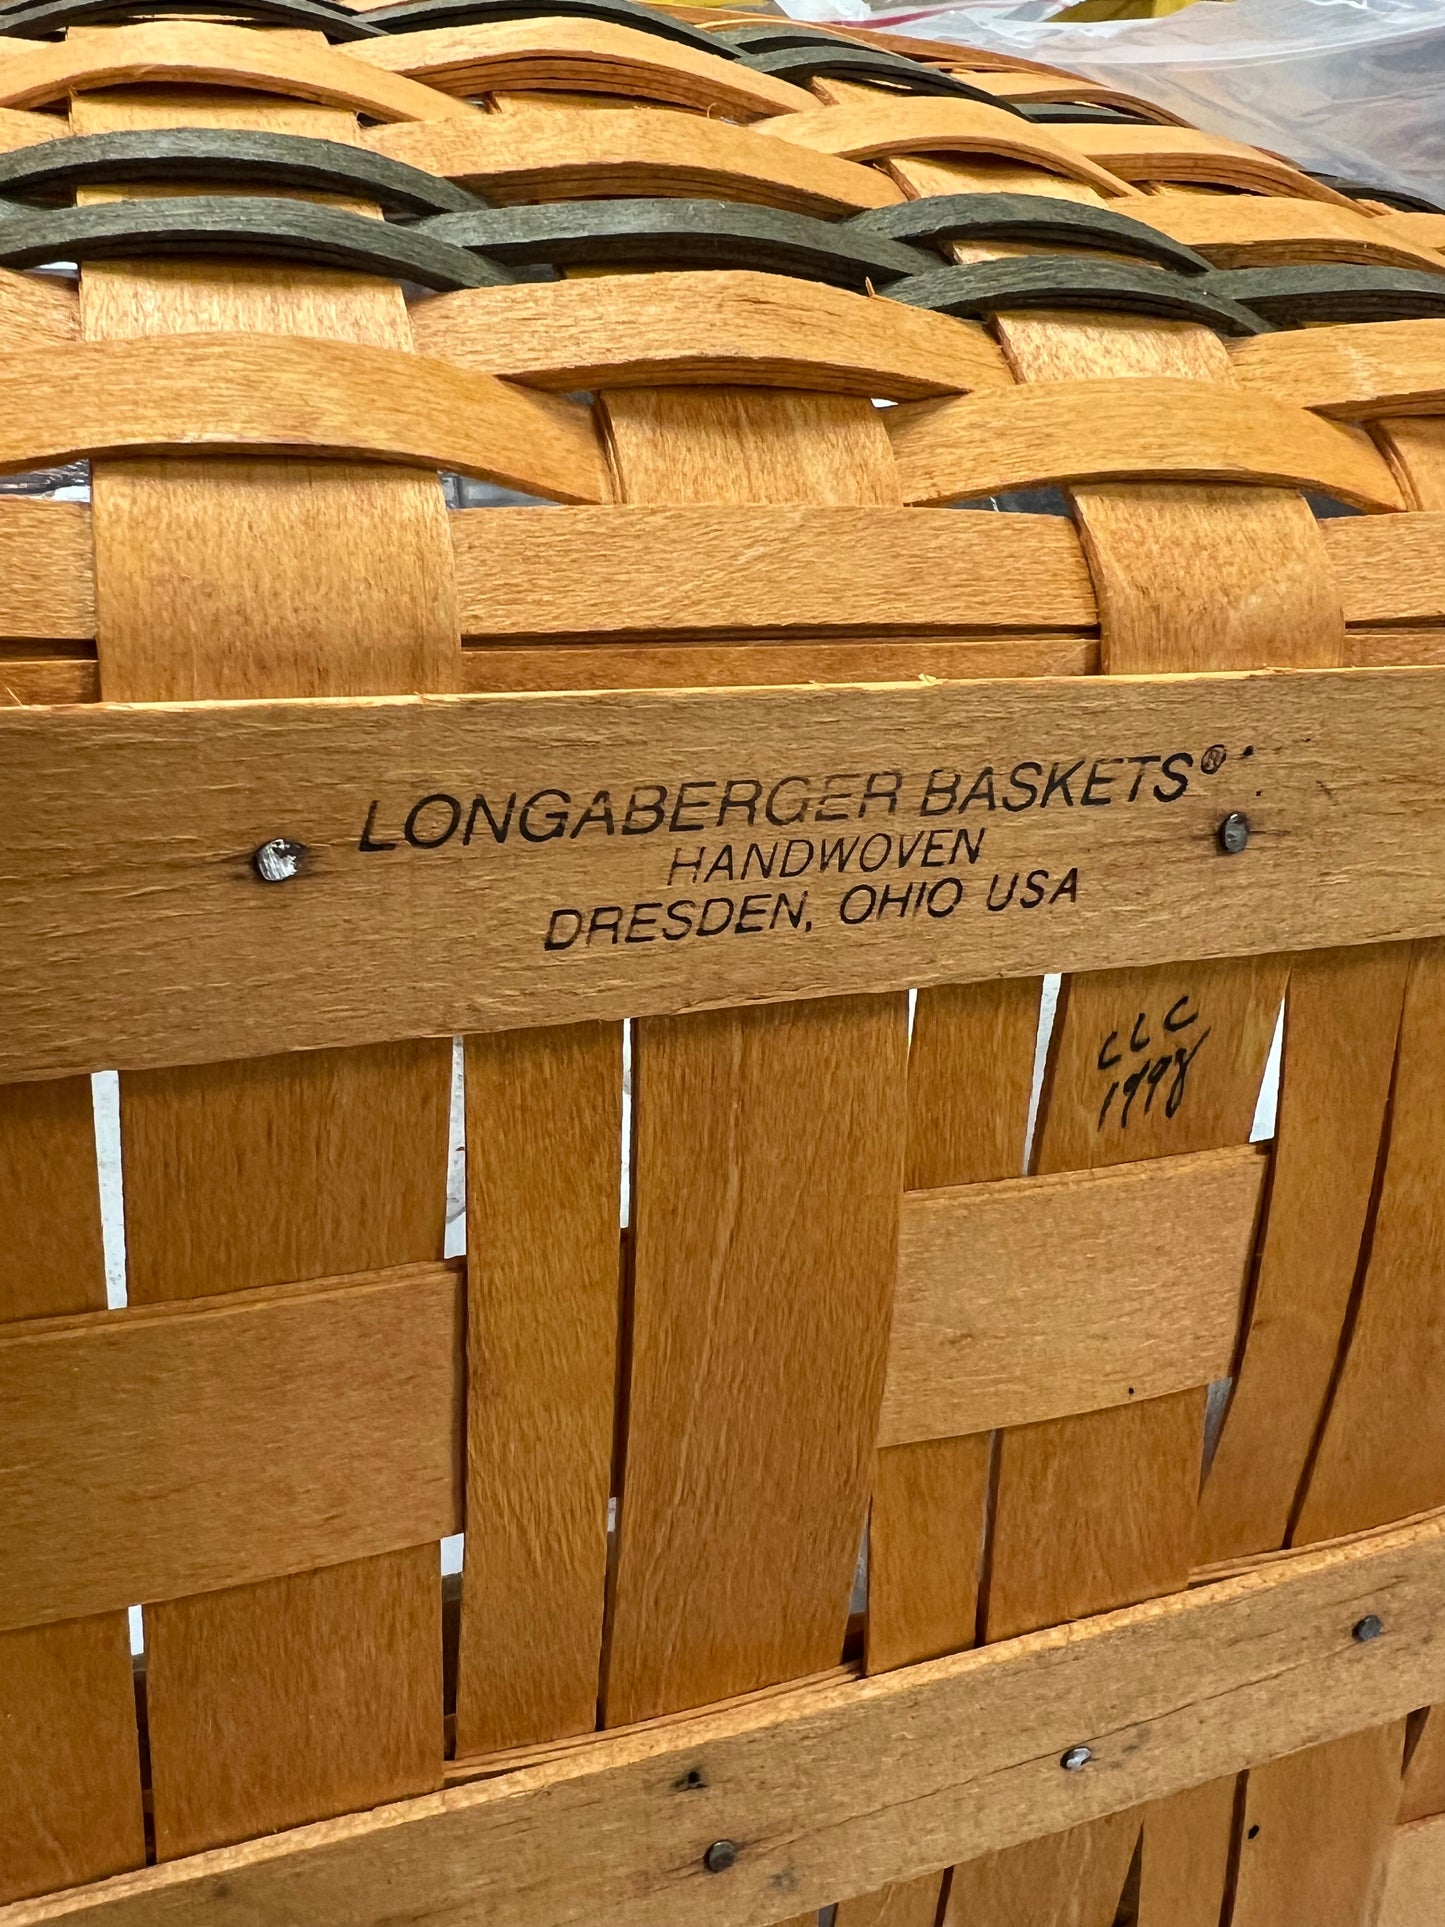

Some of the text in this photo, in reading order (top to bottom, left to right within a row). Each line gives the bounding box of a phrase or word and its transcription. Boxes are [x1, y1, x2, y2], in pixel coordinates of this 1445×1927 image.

[358, 769, 902, 853] LONGABERGER
[666, 827, 986, 887] HANDWOVEN
[543, 866, 1079, 952] DRESDEN, OHIO USA
[1096, 1025, 1212, 1133] 1998
